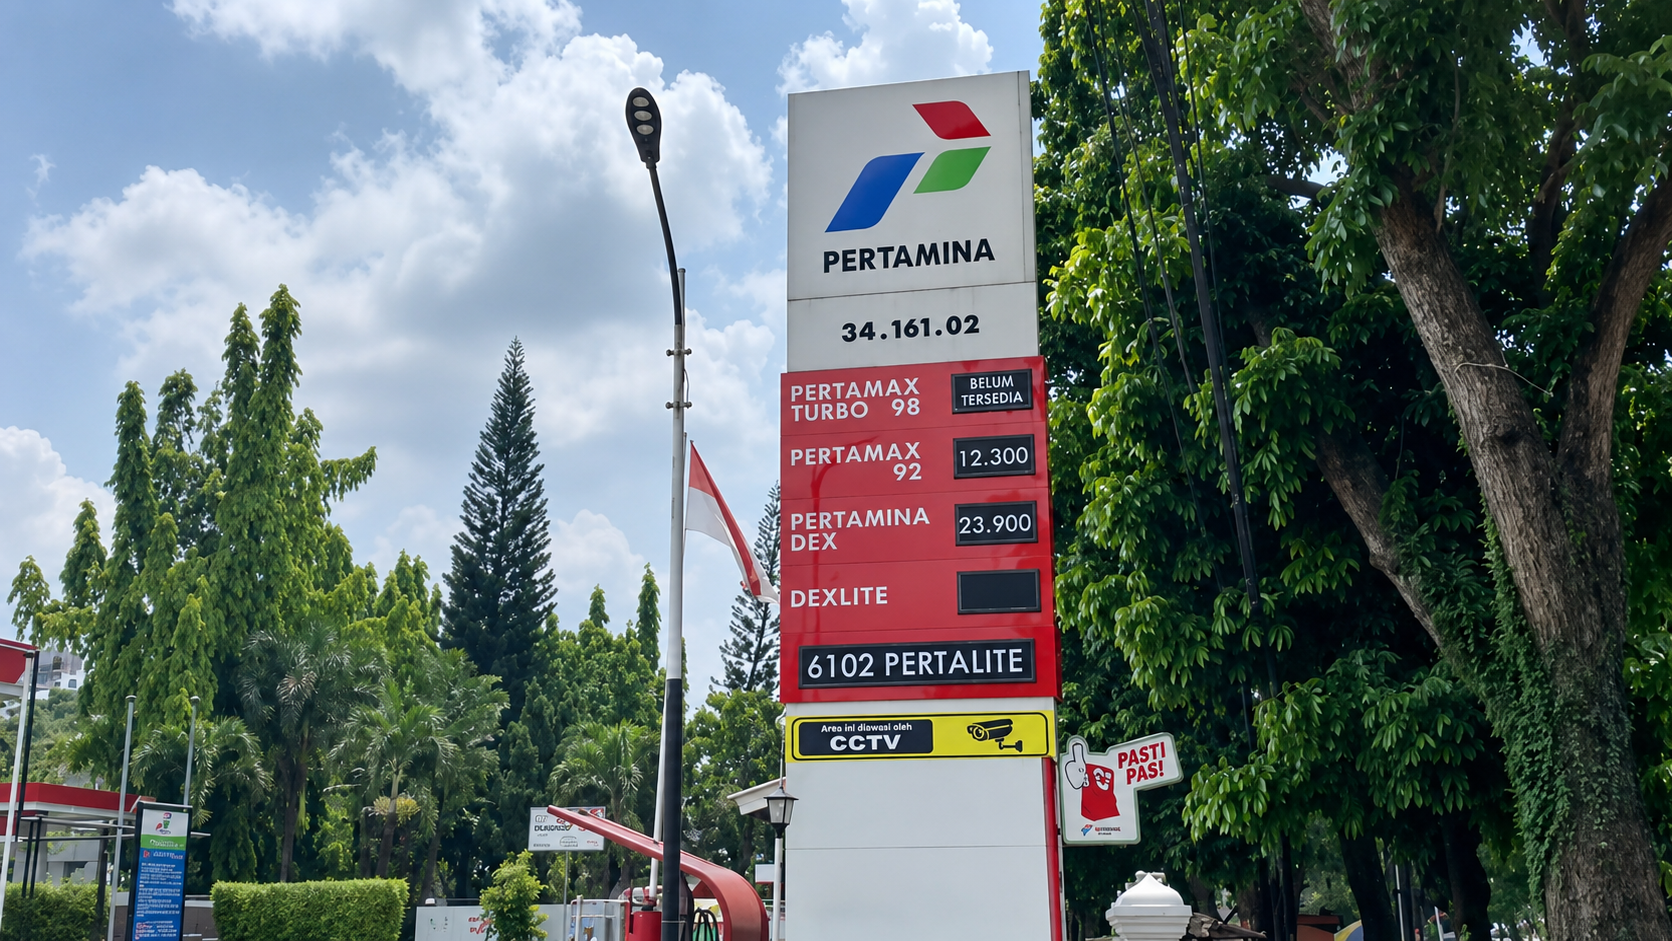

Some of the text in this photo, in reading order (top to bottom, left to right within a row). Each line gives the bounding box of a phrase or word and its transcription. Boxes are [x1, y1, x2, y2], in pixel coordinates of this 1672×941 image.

[823, 238, 995, 273] PERTAMINA
[841, 314, 980, 342] 34.161.02
[790, 377, 920, 402] PERTAMAX
[970, 375, 1014, 390] BELUM
[791, 397, 921, 422] TURBO 98
[961, 391, 1023, 406] TERSEDIA
[790, 441, 921, 466] PERTAMAX
[959, 446, 1029, 468] 12.300
[893, 462, 922, 481] 92
[790, 507, 930, 531] PERTAMINA
[958, 513, 1032, 535] 23.900
[791, 532, 838, 552] DEX
[790, 586, 888, 608] DEXLITE
[807, 648, 1023, 679] 6102 PERTALITE
[821, 723, 912, 733] Area ini diawasi oleh
[830, 735, 901, 751] CCTV
[1117, 741, 1166, 769] PASTI
[1126, 760, 1164, 785] PAS!
